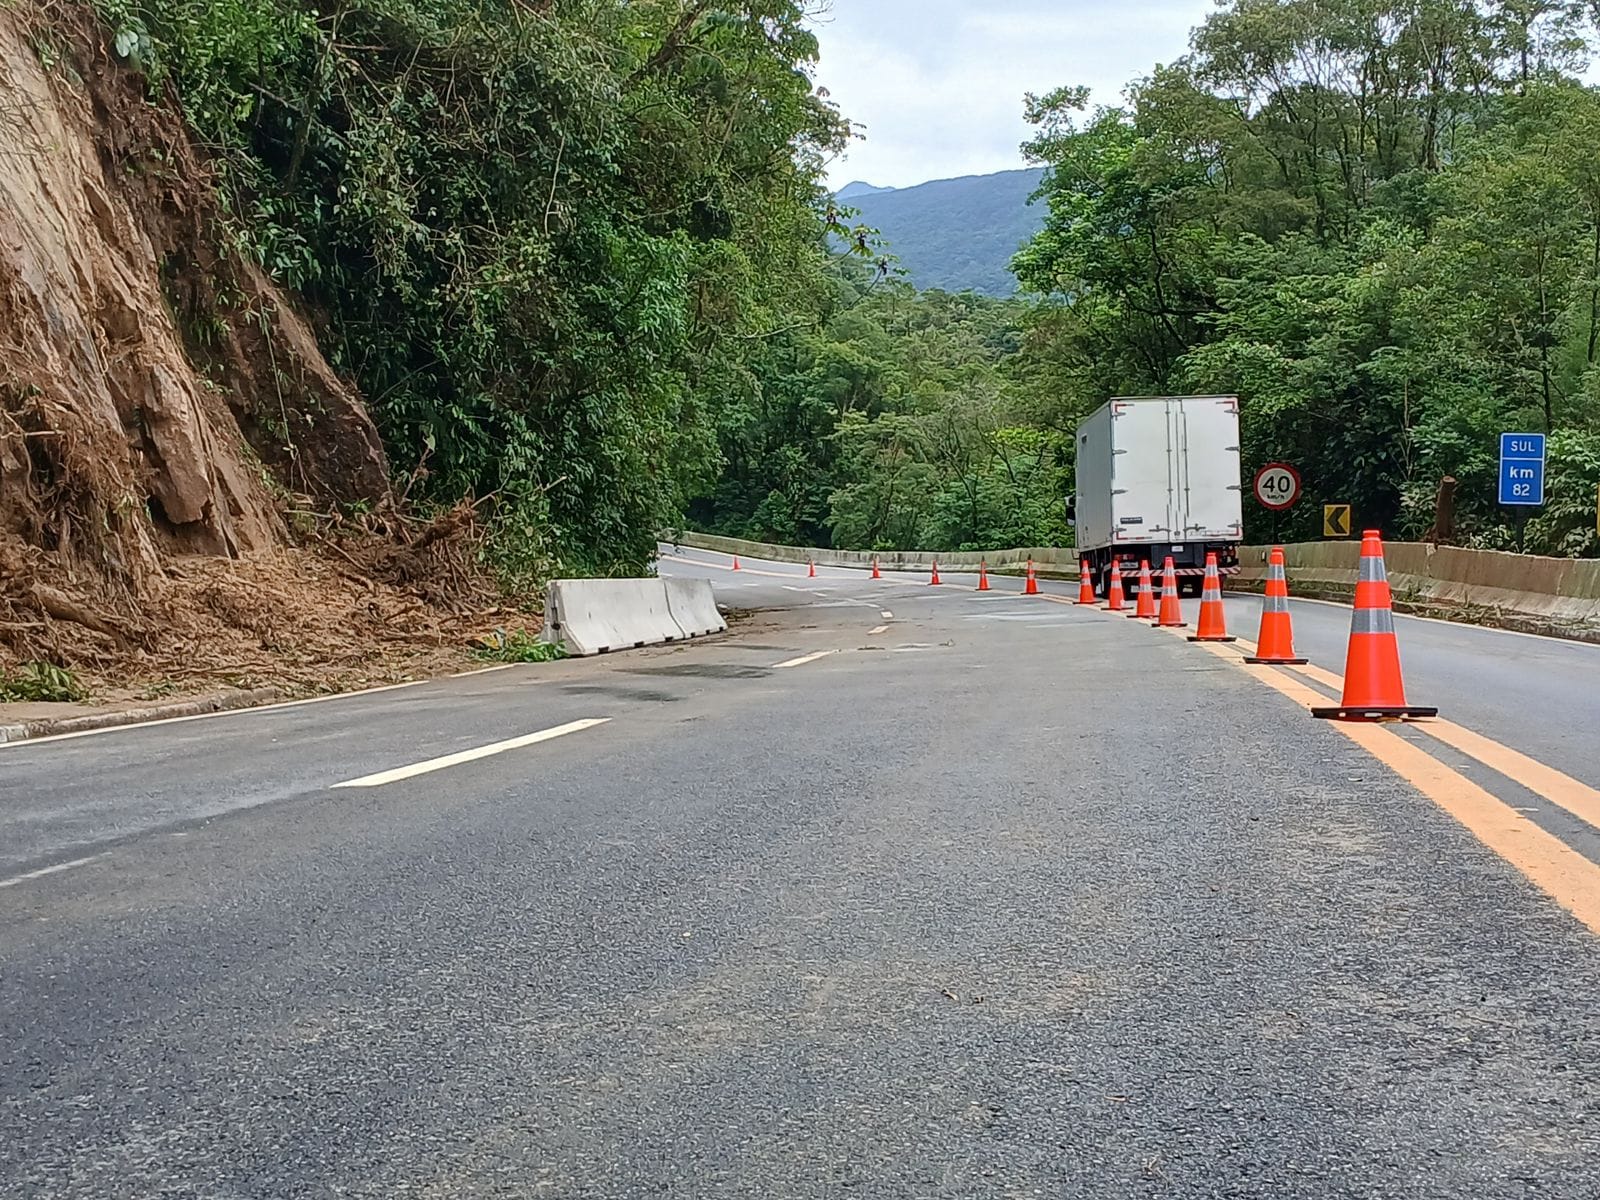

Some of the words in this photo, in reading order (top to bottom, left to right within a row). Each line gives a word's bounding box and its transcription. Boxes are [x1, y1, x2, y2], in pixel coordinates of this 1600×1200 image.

[1511, 441, 1535, 452] SUL
[1510, 466, 1534, 479] km
[1263, 475, 1290, 493] 40
[1513, 483, 1530, 496] 82
